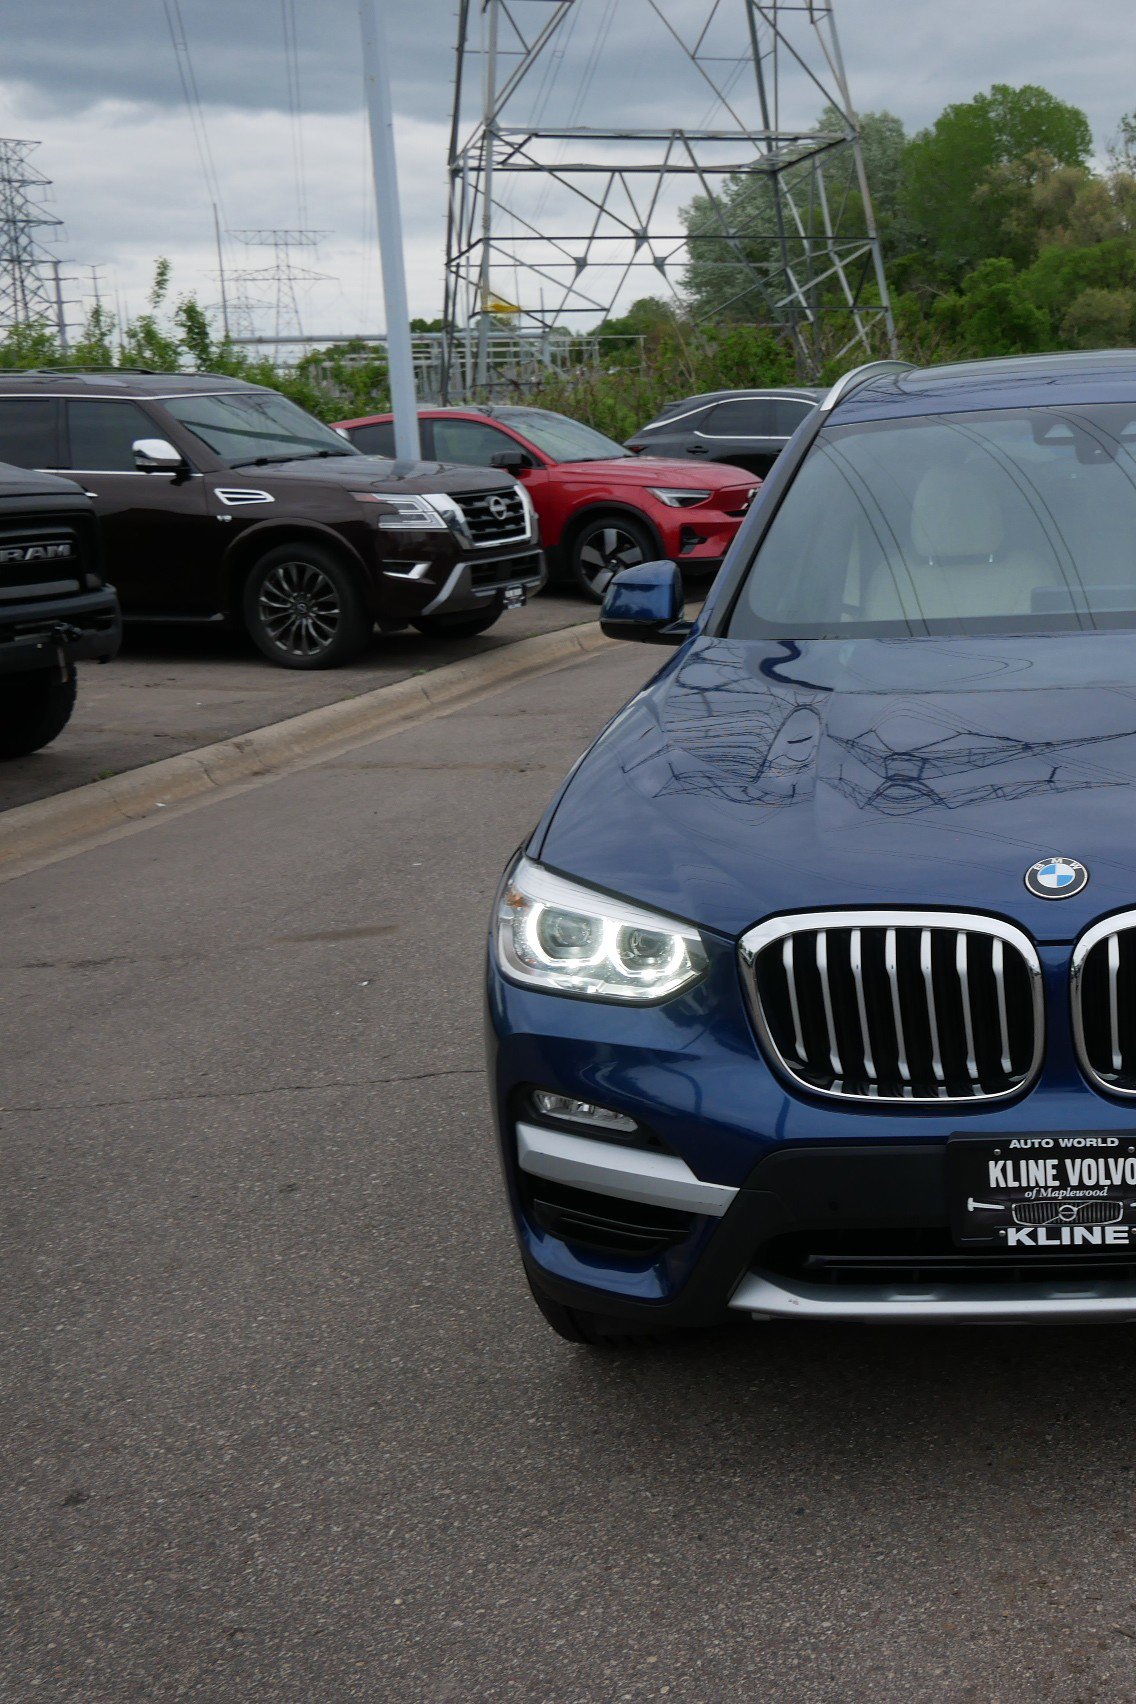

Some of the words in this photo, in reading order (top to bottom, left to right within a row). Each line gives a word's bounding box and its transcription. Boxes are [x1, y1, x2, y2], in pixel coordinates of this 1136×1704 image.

[0, 544, 71, 562] RAM
[1033, 857, 1082, 870] BMW
[1009, 1138, 1054, 1149] AUTO
[1058, 1137, 1119, 1148] WORLD
[988, 1159, 1060, 1188] KLINE
[1024, 1188, 1038, 1200] of
[1039, 1187, 1108, 1199] Maplewood
[1007, 1226, 1130, 1246] KLINE
